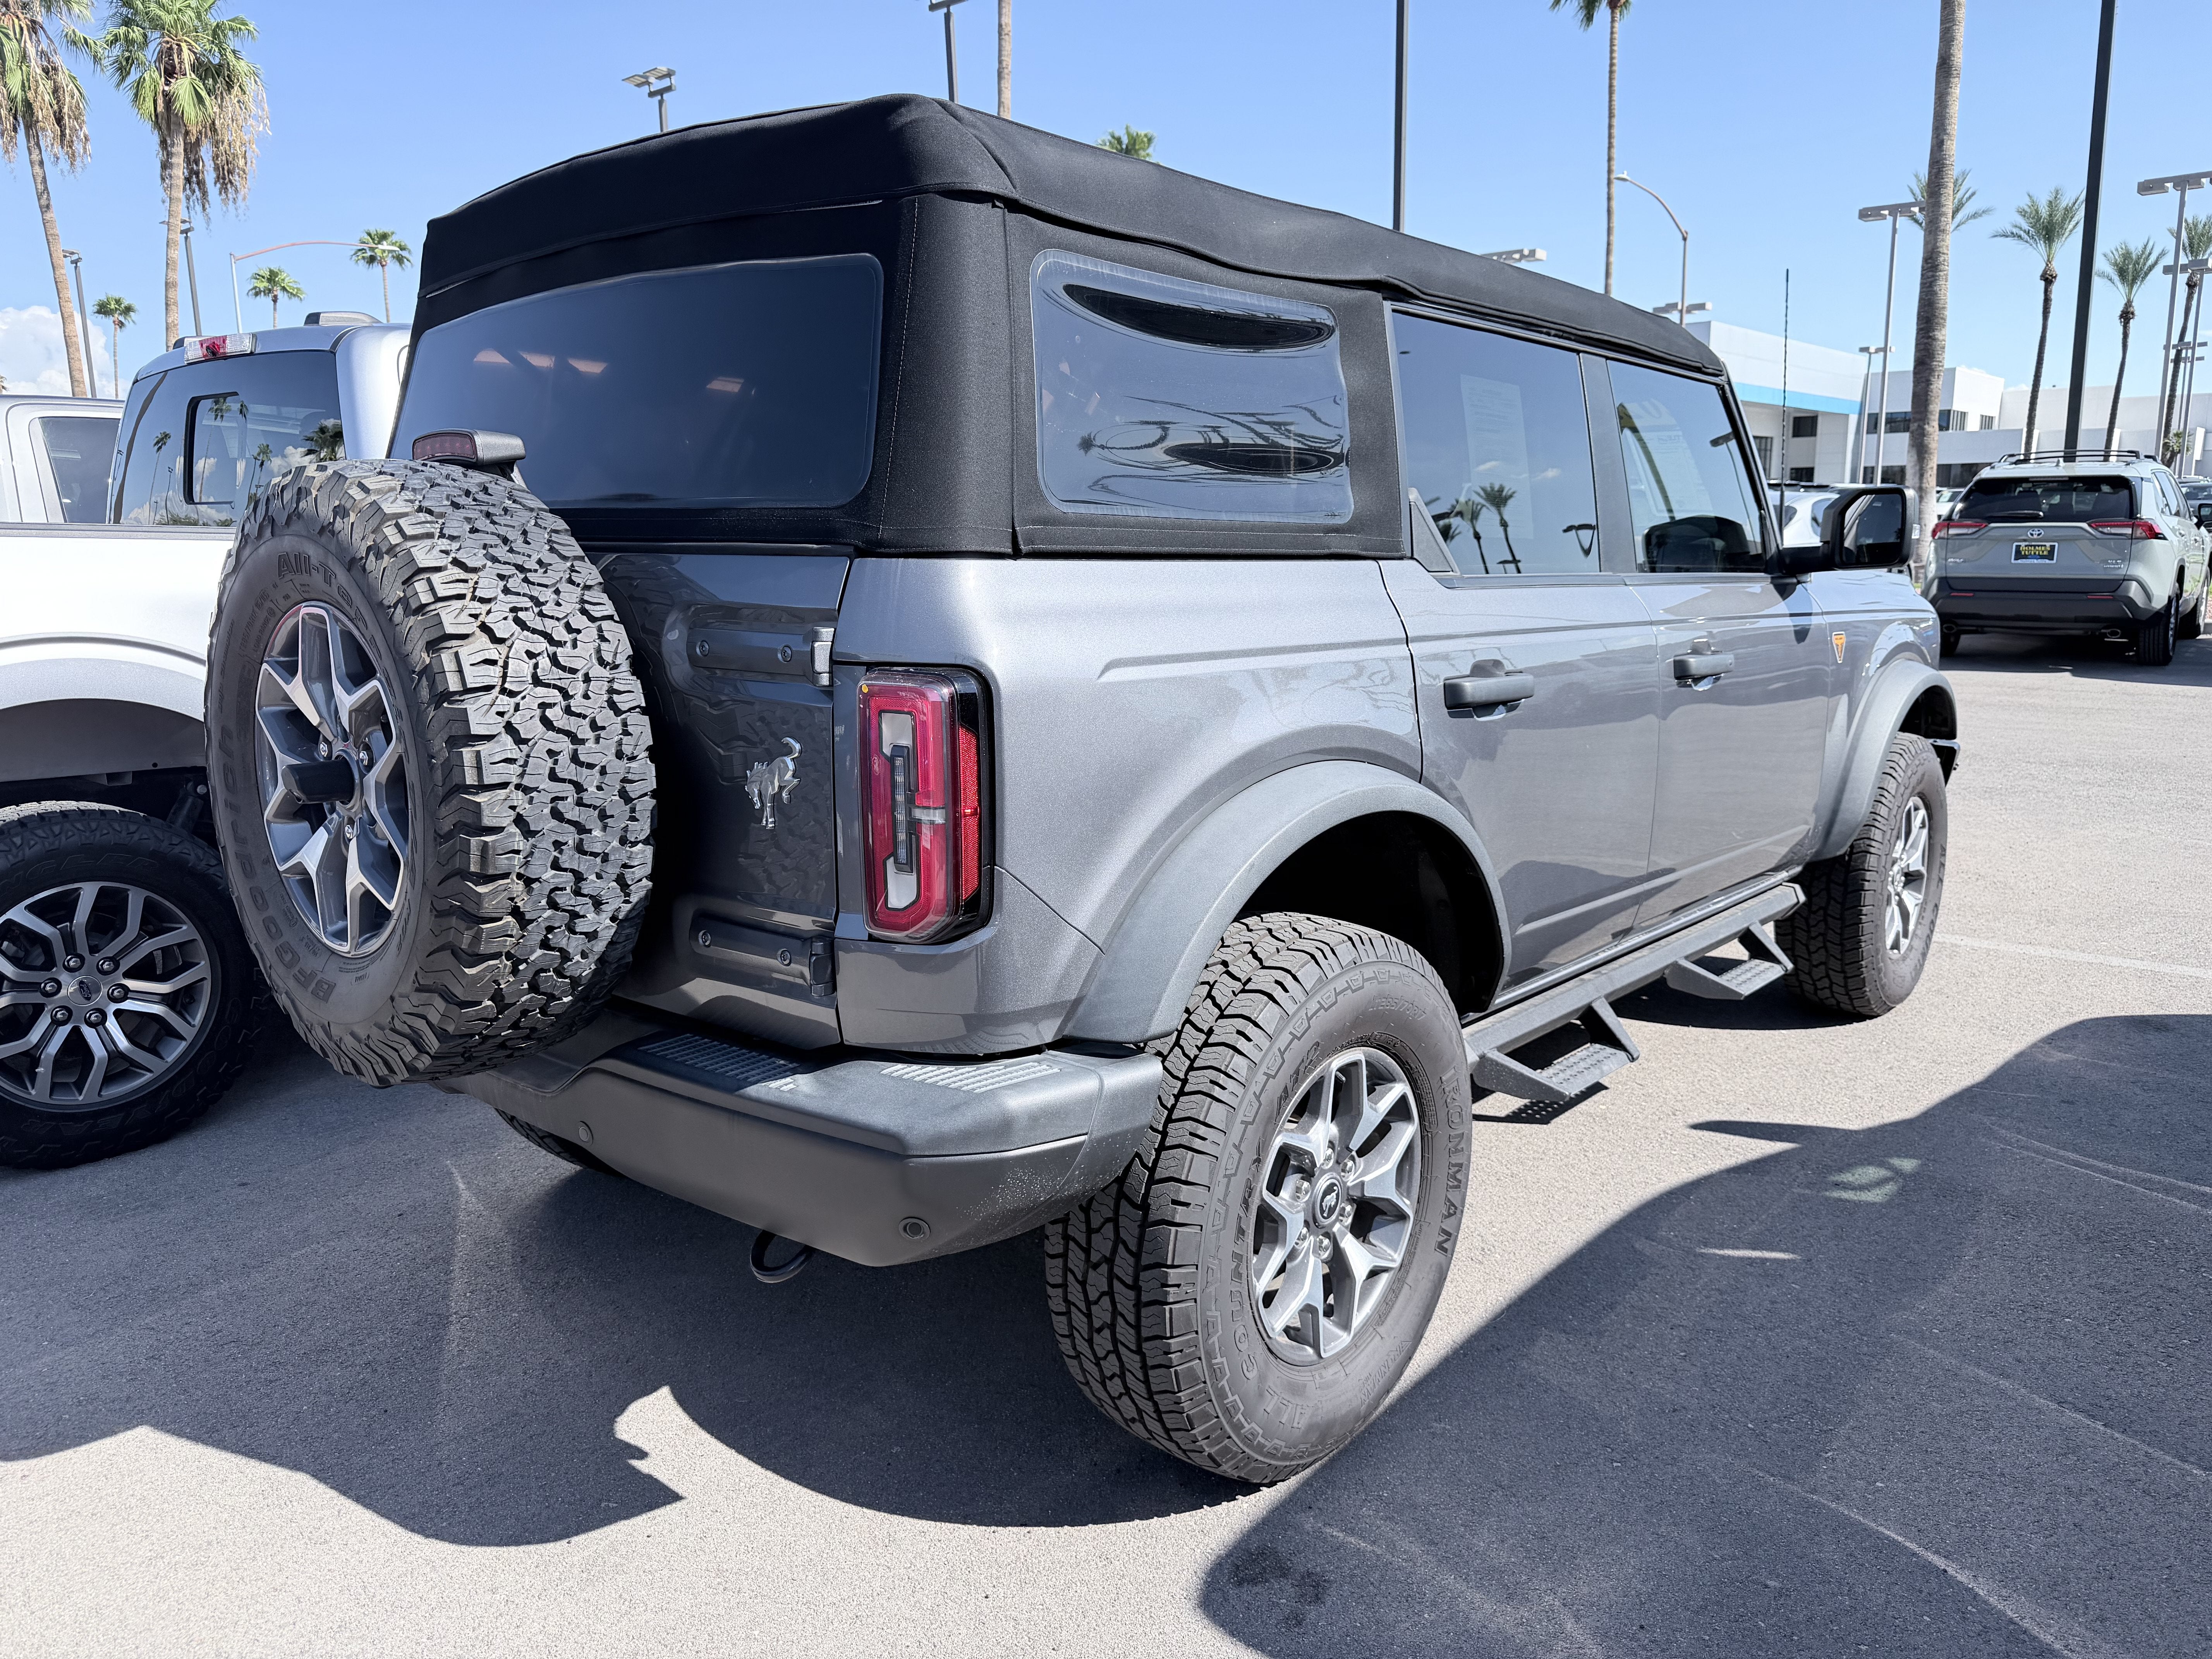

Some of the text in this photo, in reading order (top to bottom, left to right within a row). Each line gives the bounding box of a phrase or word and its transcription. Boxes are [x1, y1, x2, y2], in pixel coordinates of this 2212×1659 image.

[218, 725, 336, 1004] BFGoodrich
[80, 984, 91, 997] Ford
[1231, 1137, 1264, 1381] COUNTRY
[1434, 1066, 1464, 1257] IRONMAN
